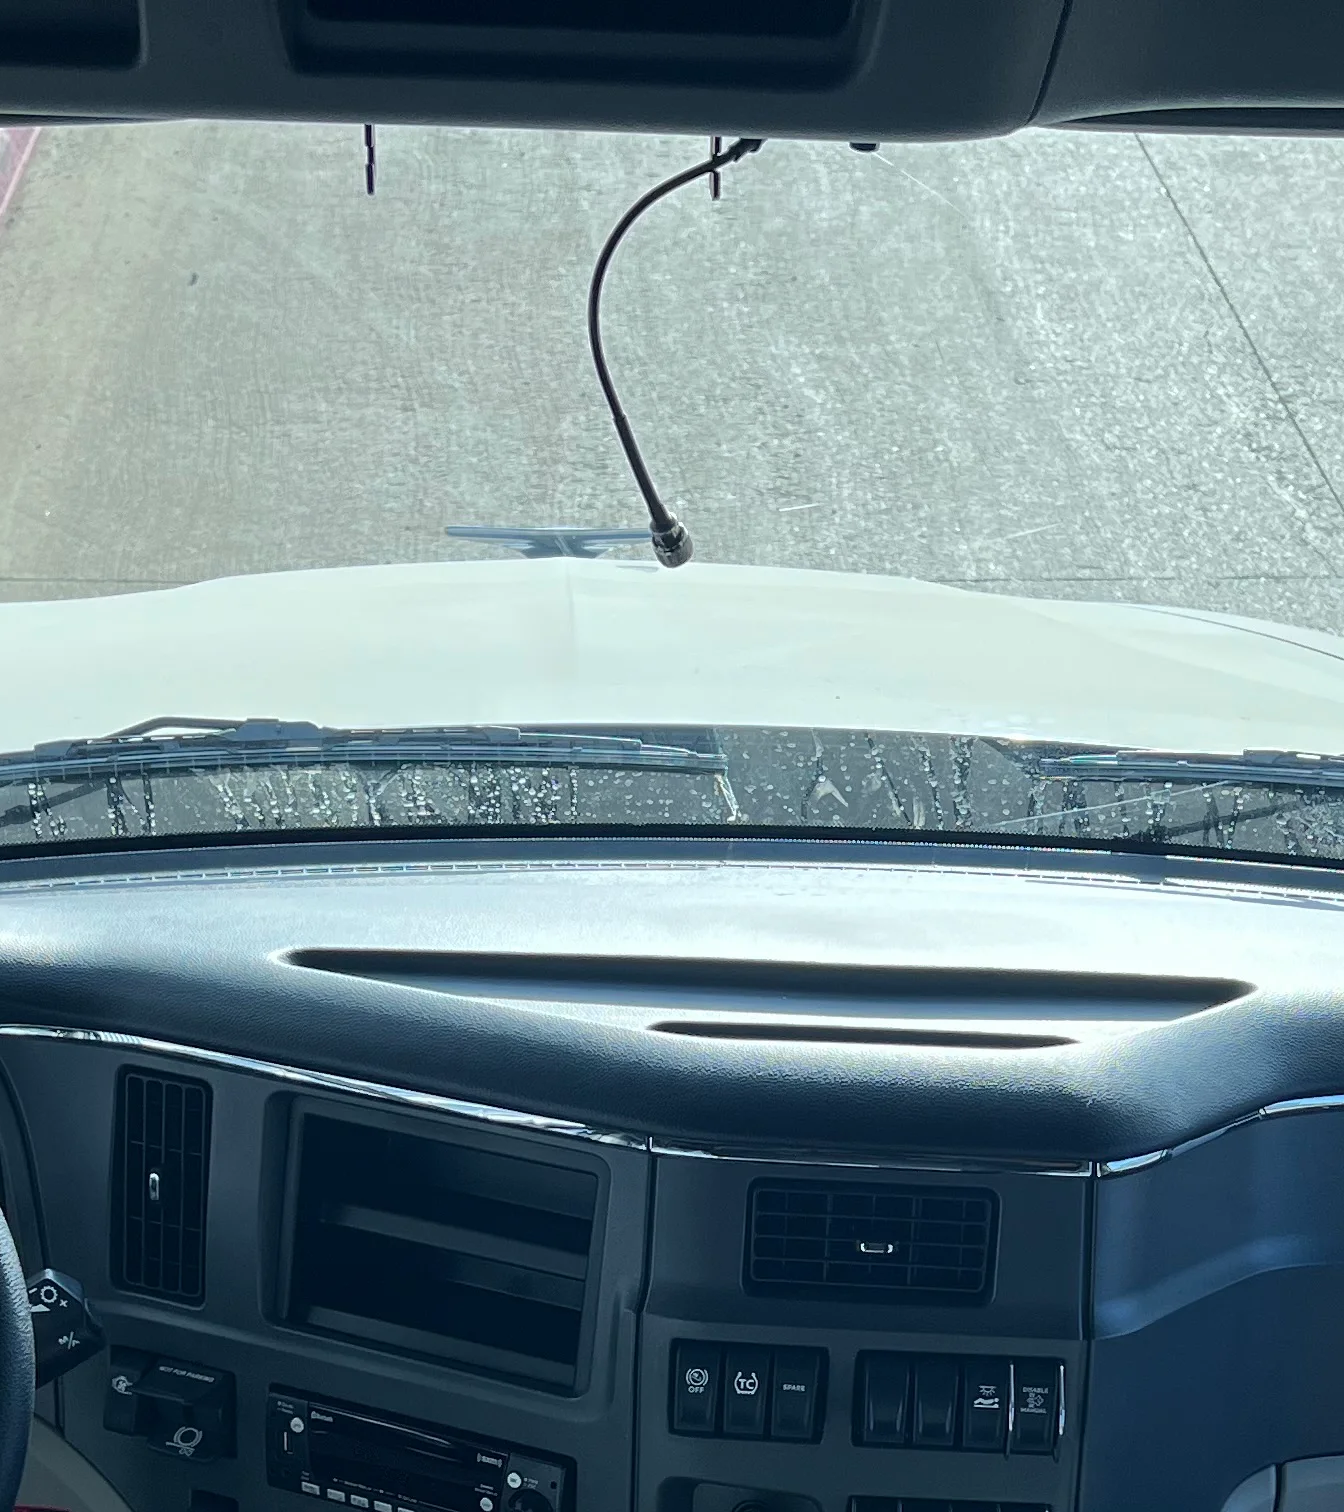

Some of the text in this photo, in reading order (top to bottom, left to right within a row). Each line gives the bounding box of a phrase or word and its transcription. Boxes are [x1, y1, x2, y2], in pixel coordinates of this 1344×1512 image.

[738, 1379, 754, 1389] TC
[782, 1383, 805, 1391] SPARE
[688, 1385, 705, 1393] OFF
